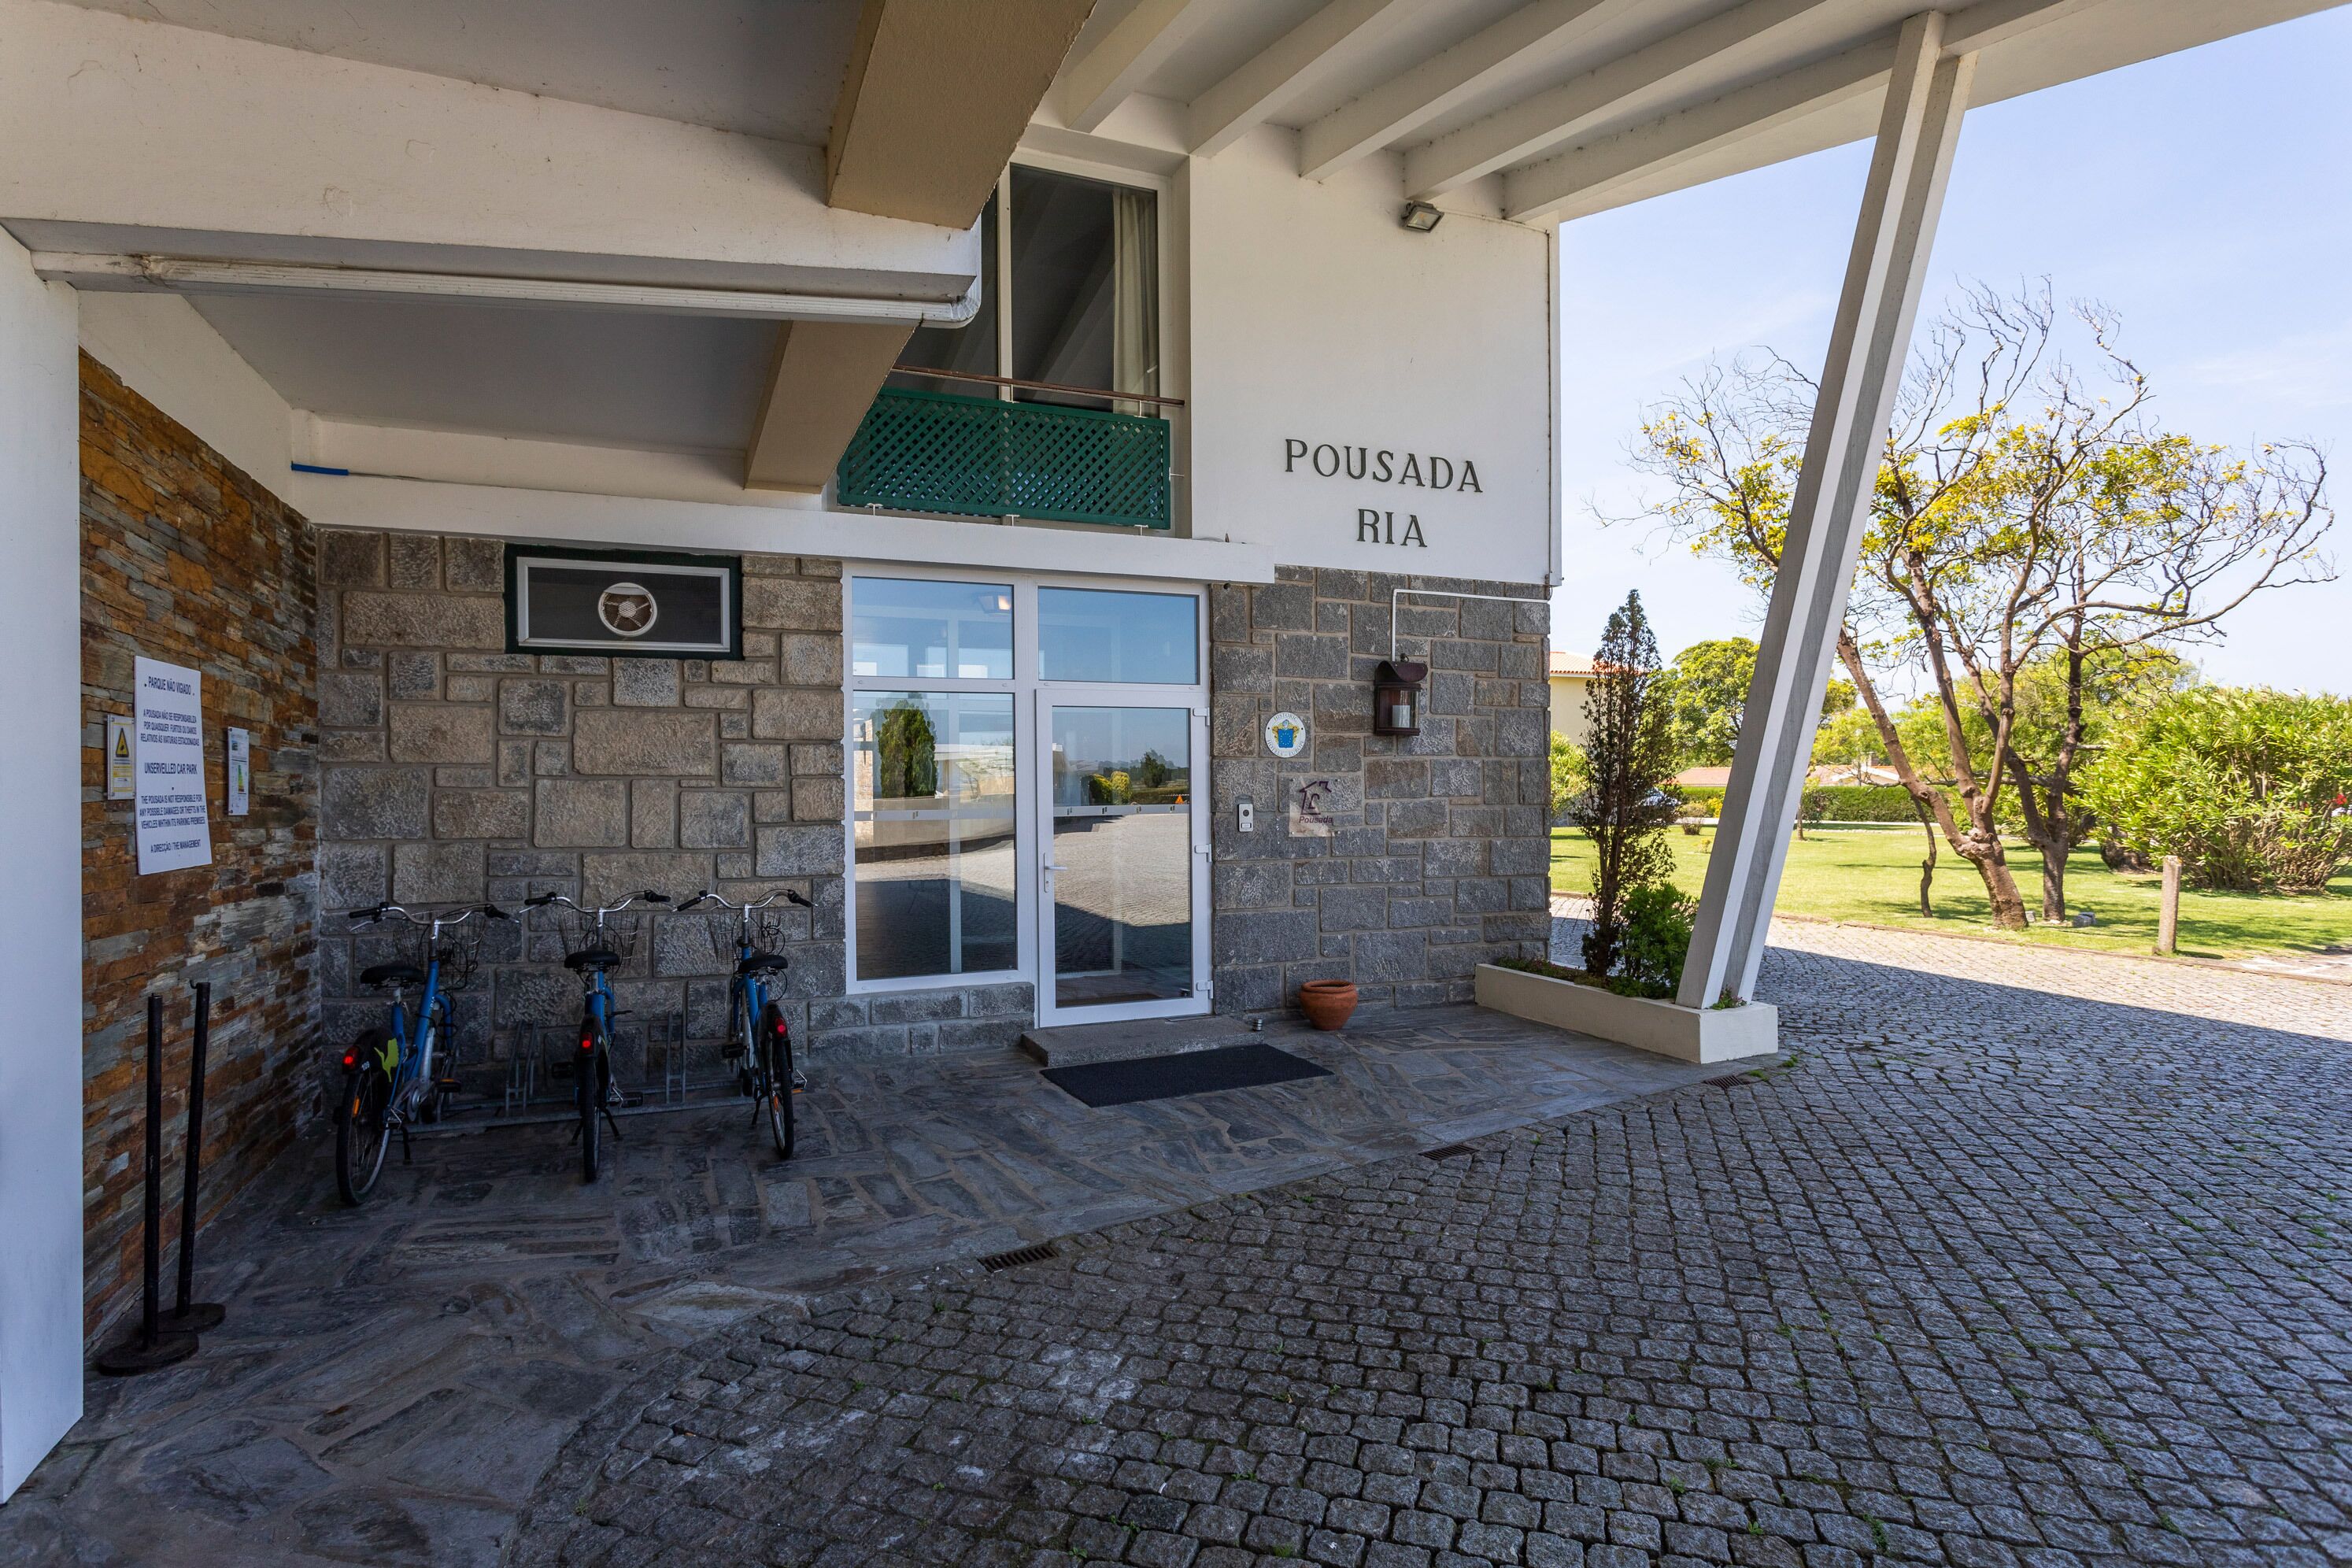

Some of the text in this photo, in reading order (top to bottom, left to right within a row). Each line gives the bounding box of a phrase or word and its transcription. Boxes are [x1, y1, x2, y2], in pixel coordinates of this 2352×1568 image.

[1285, 438, 1483, 493] POUSADA
[1356, 508, 1427, 548] RIA
[148, 676, 191, 695] PARQUE NÃO VIGIADO
[146, 709, 161, 719] POUSADA
[1273, 712, 1297, 721] HISTORIC
[141, 733, 158, 743] RELATIVOS
[177, 763, 186, 775] CAR
[187, 764, 198, 775] PARK
[149, 795, 164, 804] POUSADA
[175, 794, 196, 803] RESPONSIBLE
[147, 808, 164, 816] POSSIBLE
[141, 819, 158, 829] VEHICLES
[176, 817, 190, 826] PARKING
